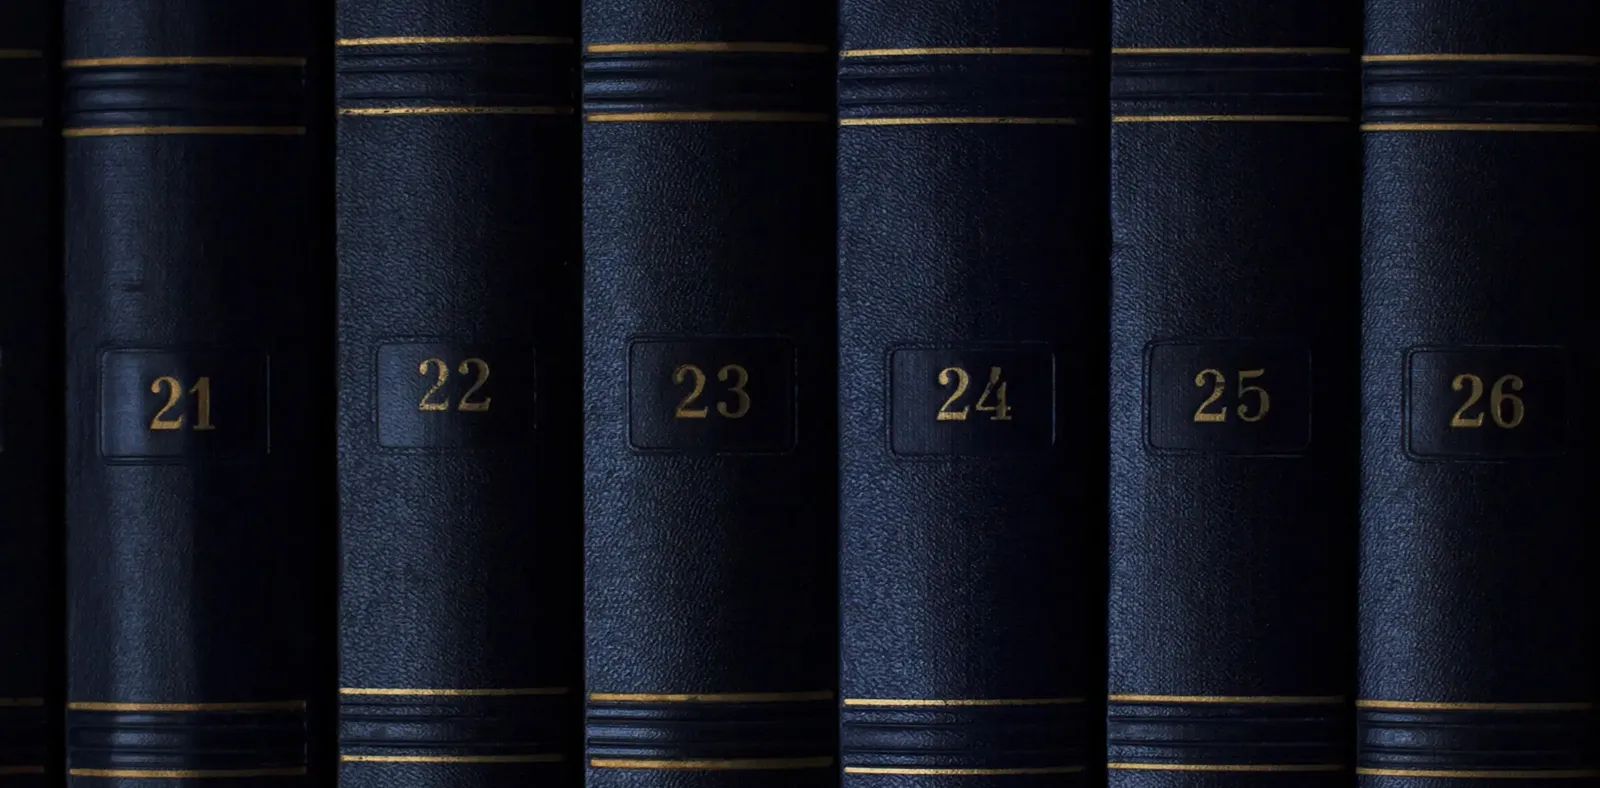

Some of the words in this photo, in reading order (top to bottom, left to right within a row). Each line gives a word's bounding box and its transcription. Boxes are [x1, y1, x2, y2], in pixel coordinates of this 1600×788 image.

[150, 376, 216, 430] 21
[418, 359, 491, 412] 22
[674, 364, 751, 418] 23
[936, 366, 1013, 421] 24
[1193, 369, 1270, 422] 25
[1450, 373, 1525, 428] 26
